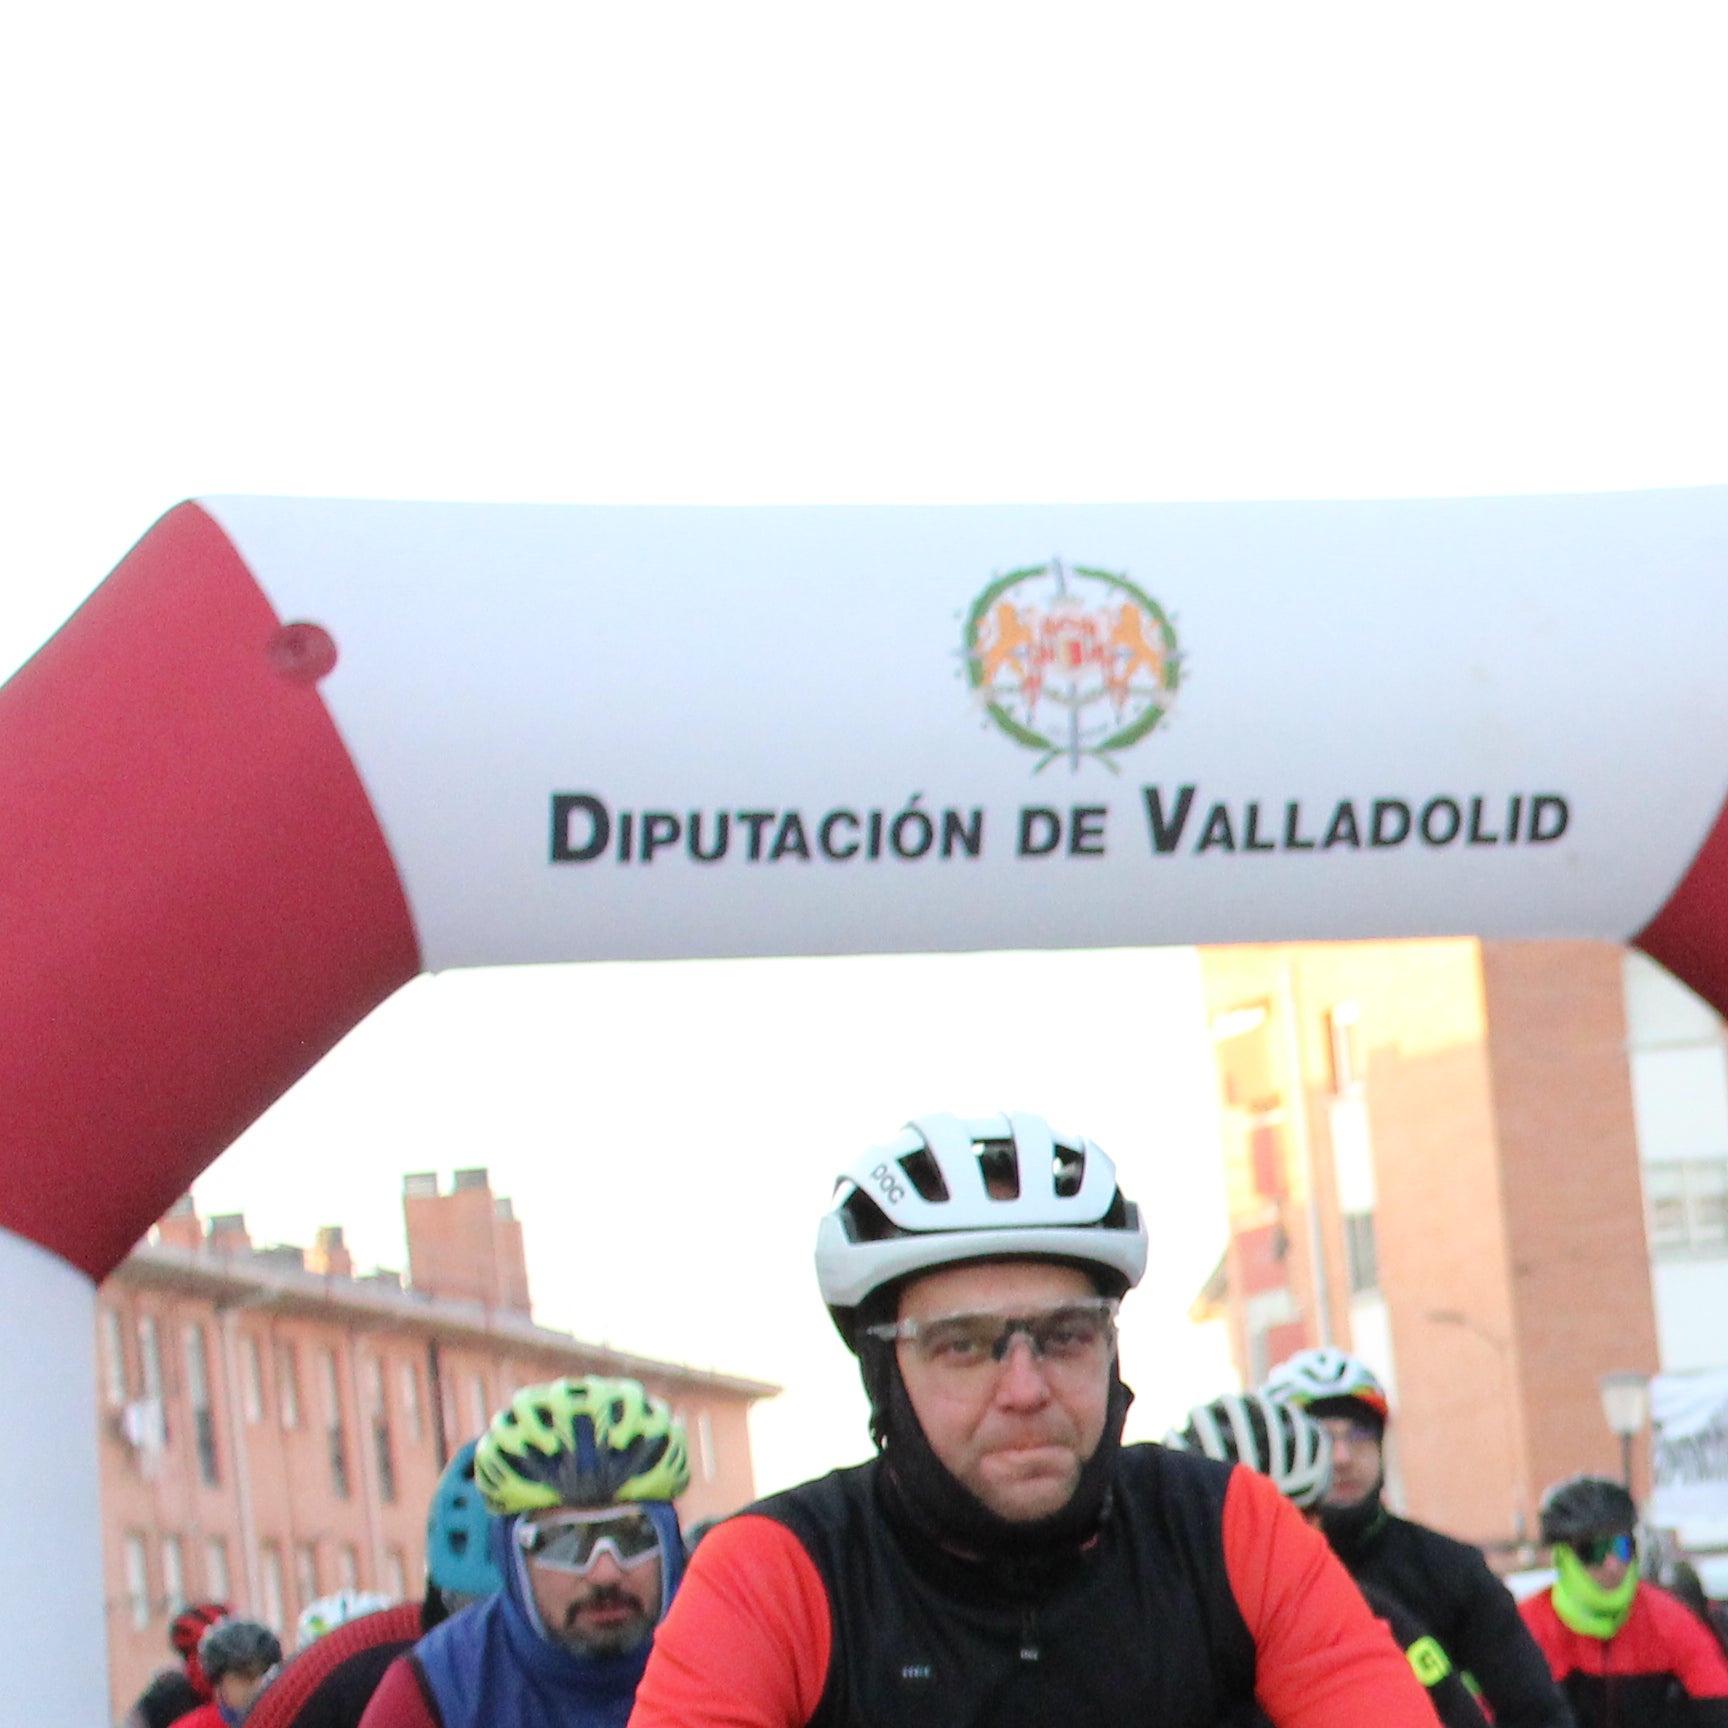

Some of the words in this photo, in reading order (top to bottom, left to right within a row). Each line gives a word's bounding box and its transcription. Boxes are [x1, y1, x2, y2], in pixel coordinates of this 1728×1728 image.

[548, 789, 984, 864] DIPUTACIÓN
[1017, 802, 1108, 857] DE
[1142, 784, 1571, 857] VALLADOLID
